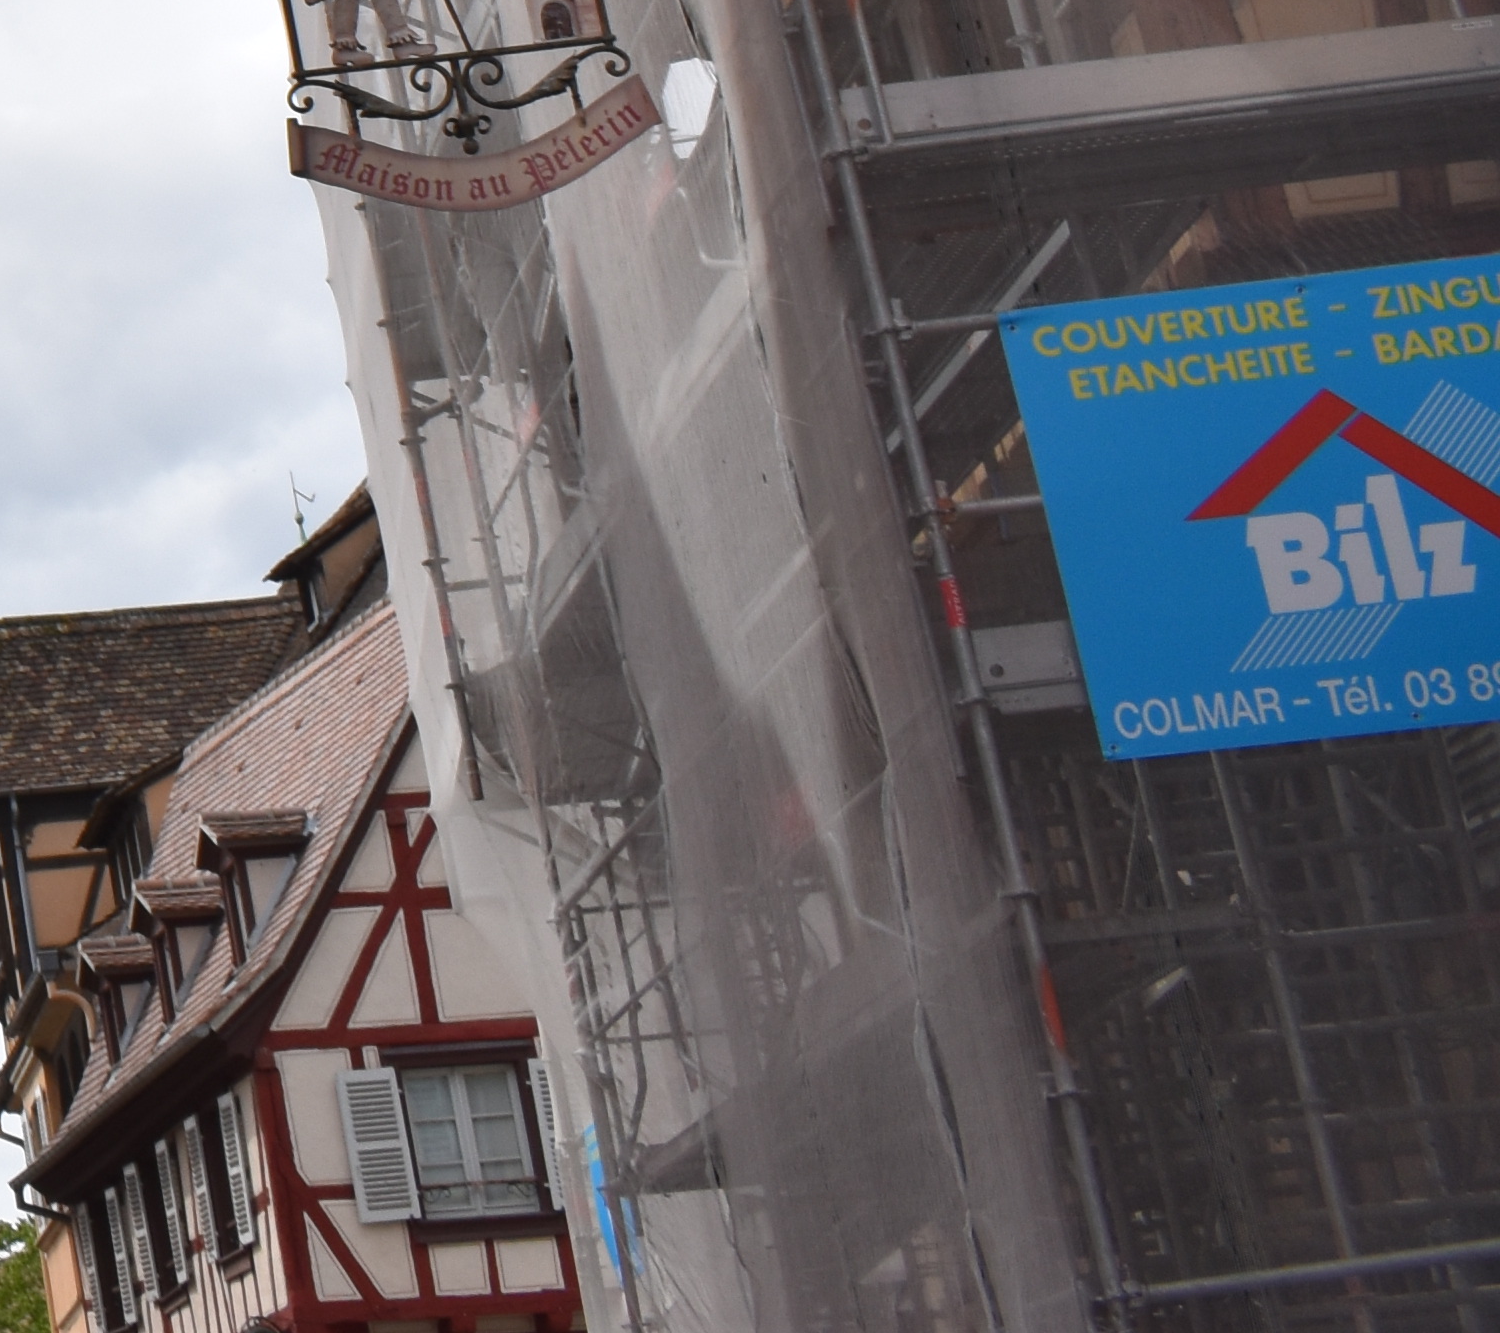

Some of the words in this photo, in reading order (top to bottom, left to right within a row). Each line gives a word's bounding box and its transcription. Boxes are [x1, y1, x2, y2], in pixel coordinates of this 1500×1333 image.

[314, 141, 456, 203] Maison
[468, 172, 512, 203] au
[518, 103, 642, 192] Pélerin
[1031, 297, 1310, 358] COUVERTURE
[1366, 273, 1500, 320] ZINGU
[1068, 342, 1316, 401] ETANCHEITE
[1372, 319, 1500, 365] BARD
[1245, 473, 1476, 615] Bilz
[1113, 685, 1285, 740] COLMAR
[1316, 675, 1394, 718] Tél.
[1404, 667, 1457, 709] 03
